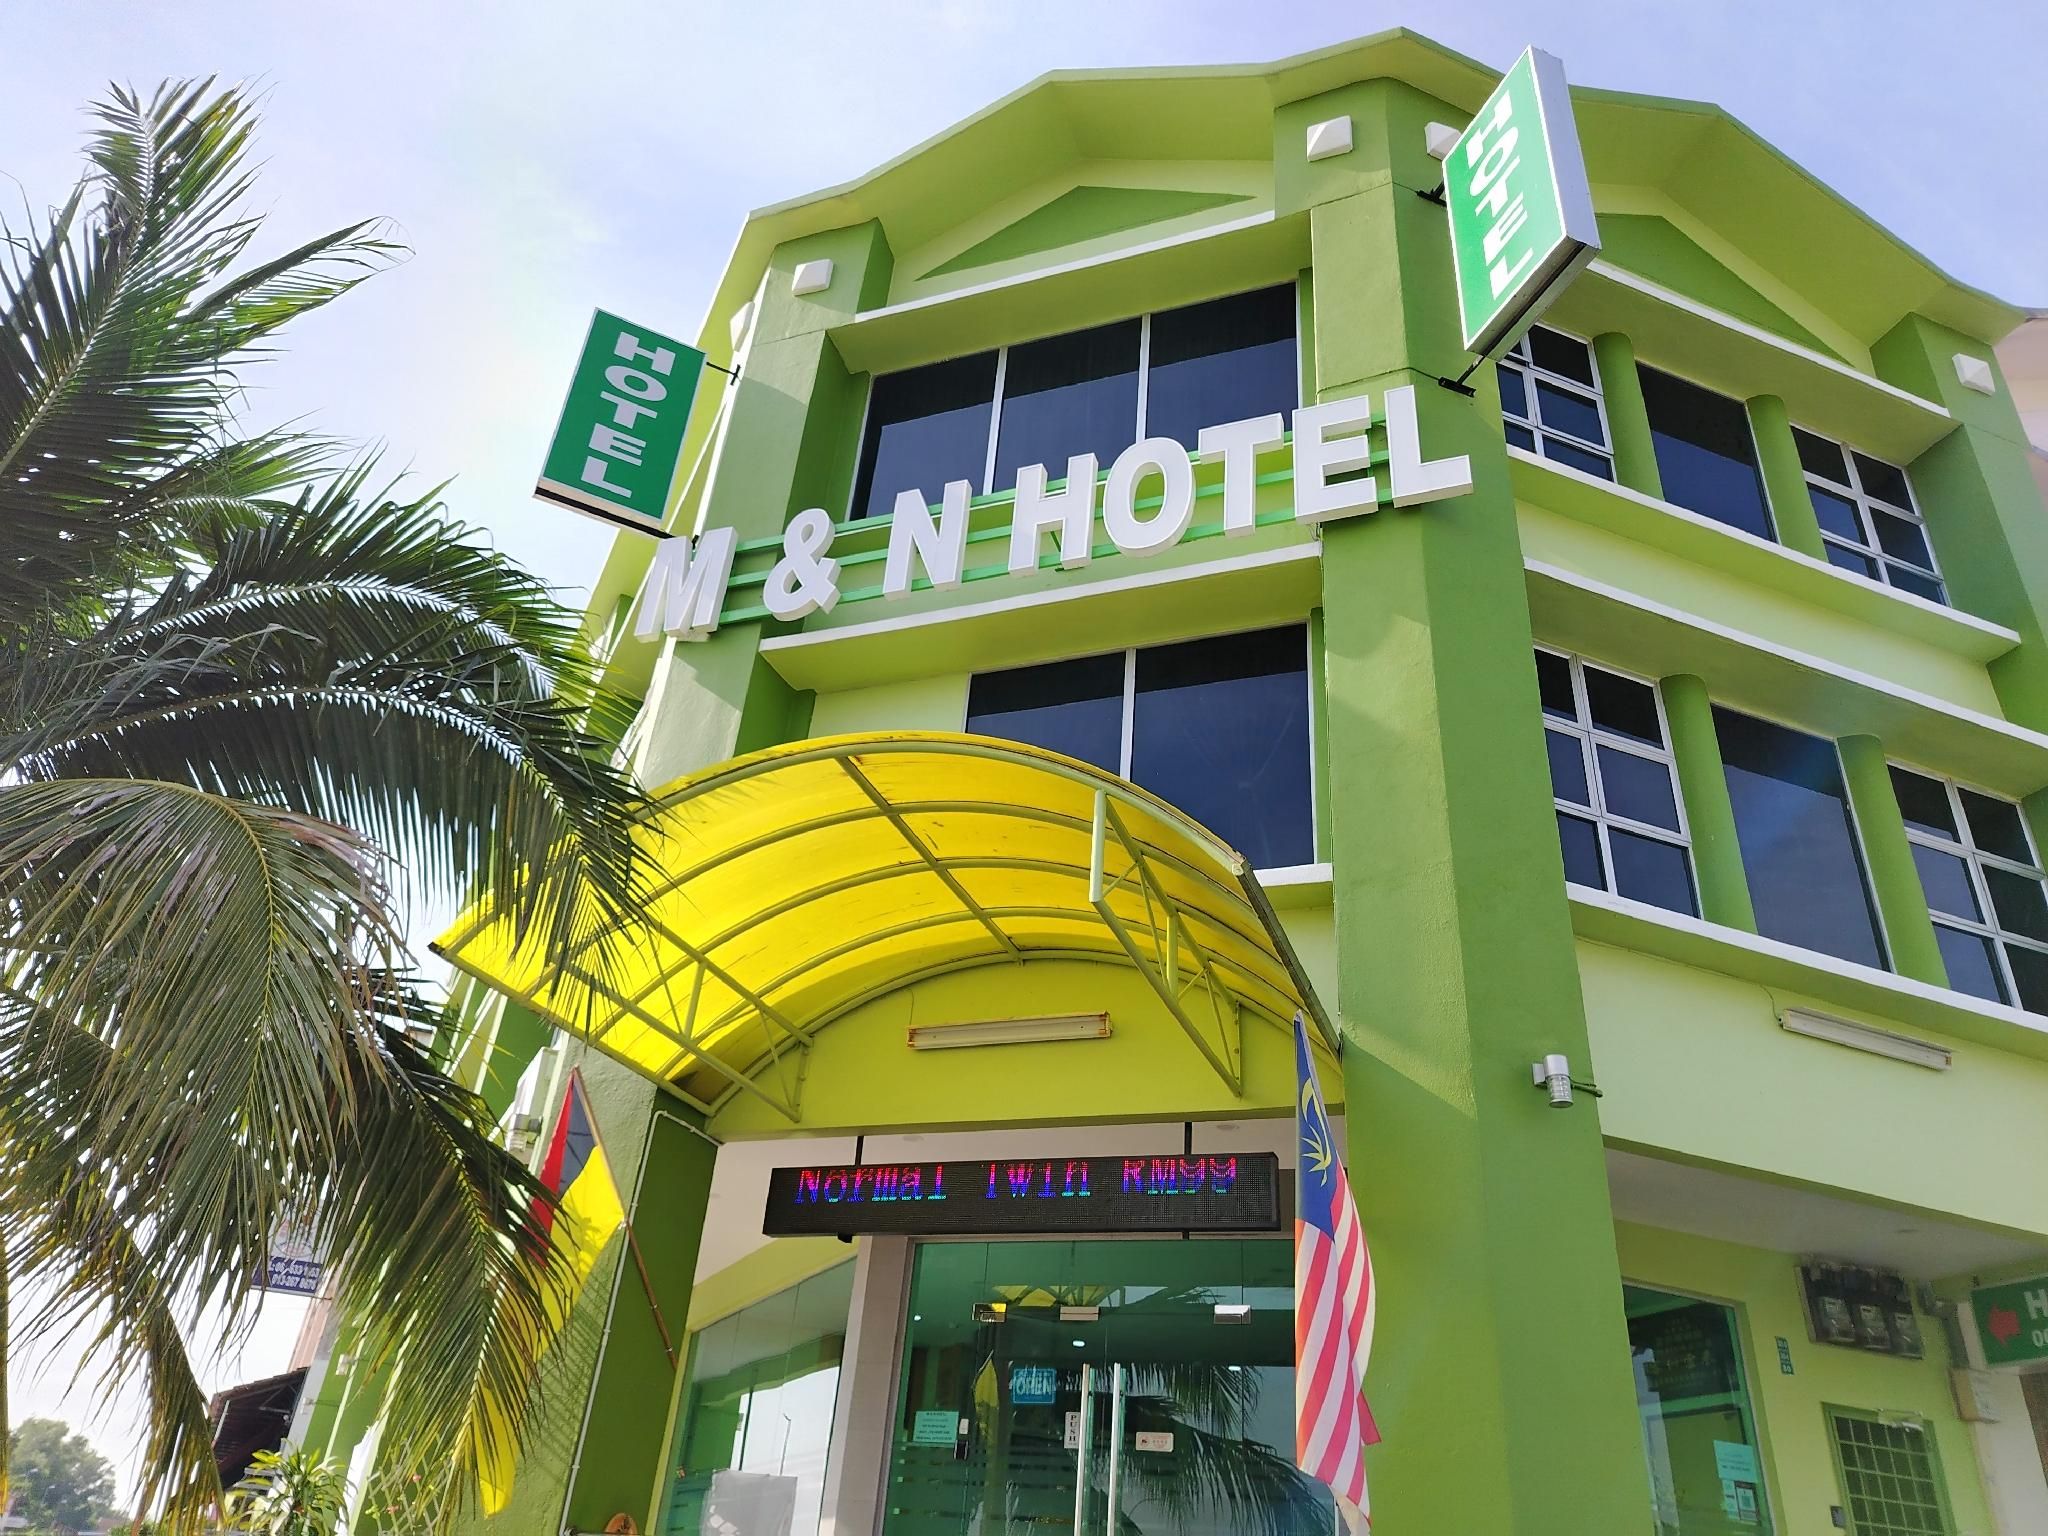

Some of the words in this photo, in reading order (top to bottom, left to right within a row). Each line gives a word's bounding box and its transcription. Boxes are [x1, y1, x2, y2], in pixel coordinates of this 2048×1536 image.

[1465, 89, 1534, 301] HOTEL
[580, 331, 676, 499] HOTEL
[634, 526, 738, 643] M
[763, 507, 841, 622] &
[883, 478, 972, 601] N
[1008, 384, 1474, 577] HOTEL
[795, 1162, 947, 1204] Normal
[1068, 1414, 1078, 1442] PUSH
